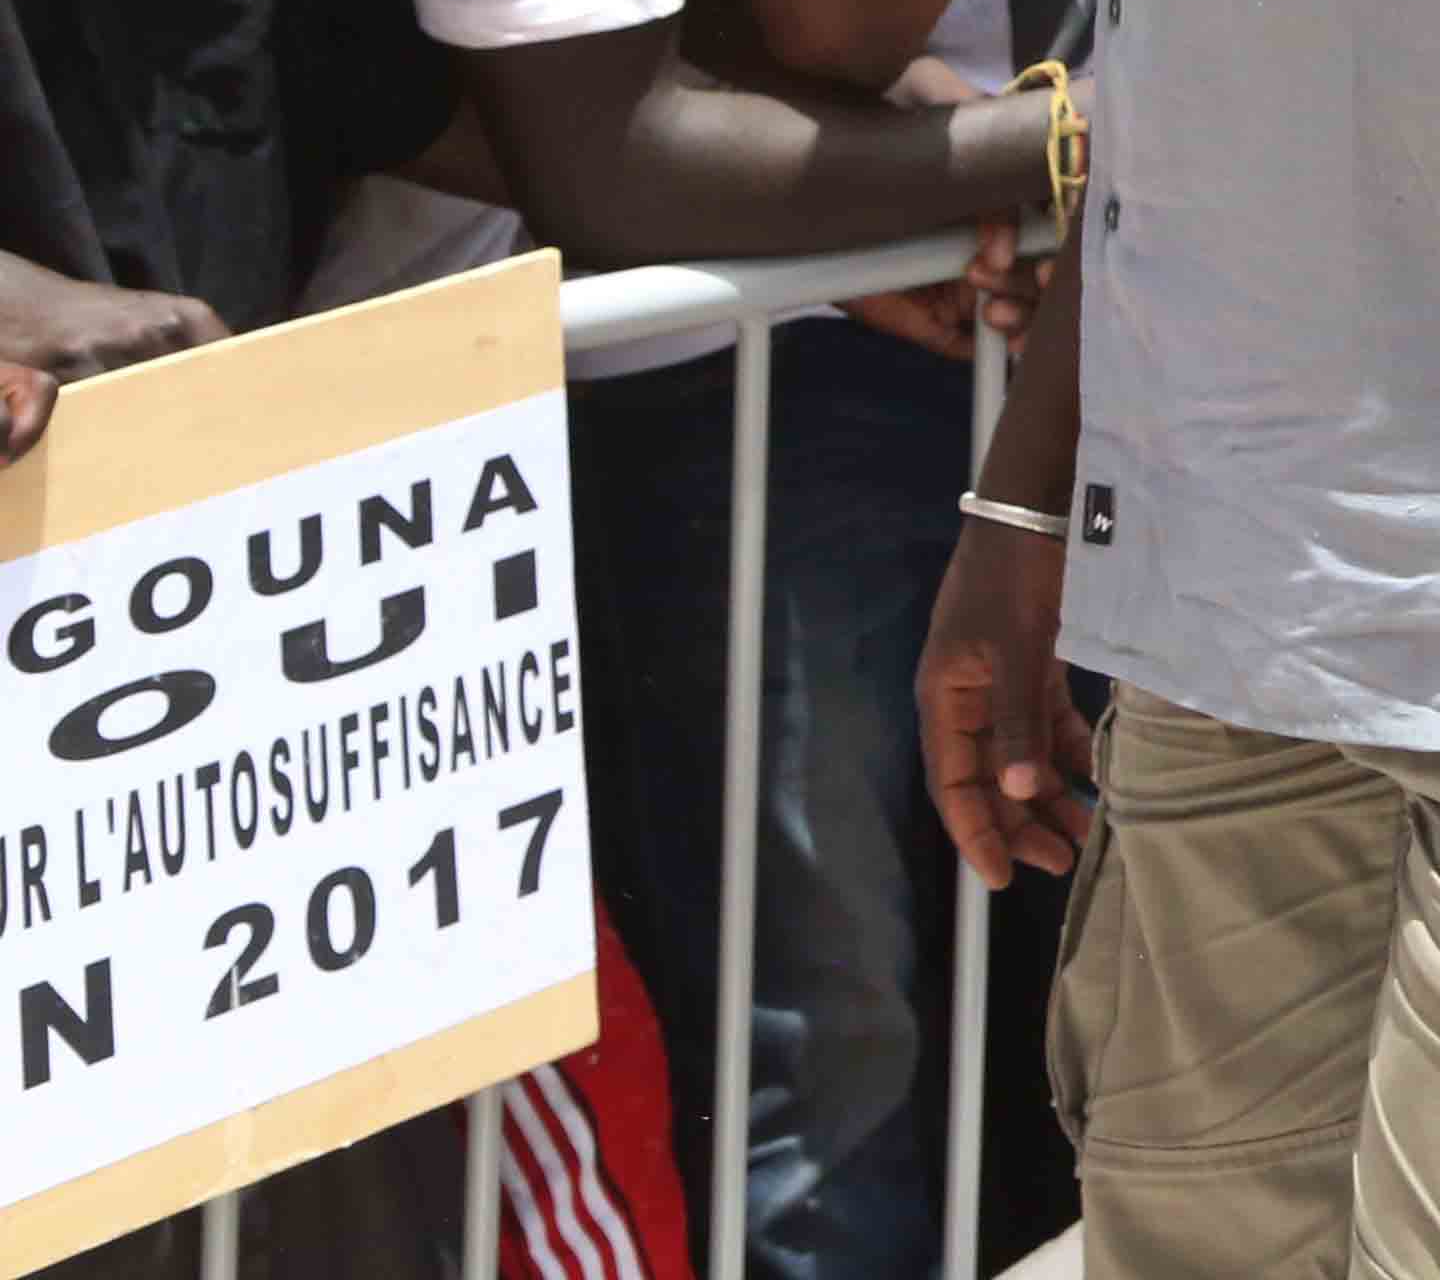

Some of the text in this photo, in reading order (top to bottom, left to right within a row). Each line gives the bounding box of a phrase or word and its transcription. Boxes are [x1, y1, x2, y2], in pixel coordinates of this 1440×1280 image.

[47, 548, 540, 762] OUI
[74, 637, 577, 911] L'AUTOSUFFISANCE
[203, 787, 564, 1020] 2017
